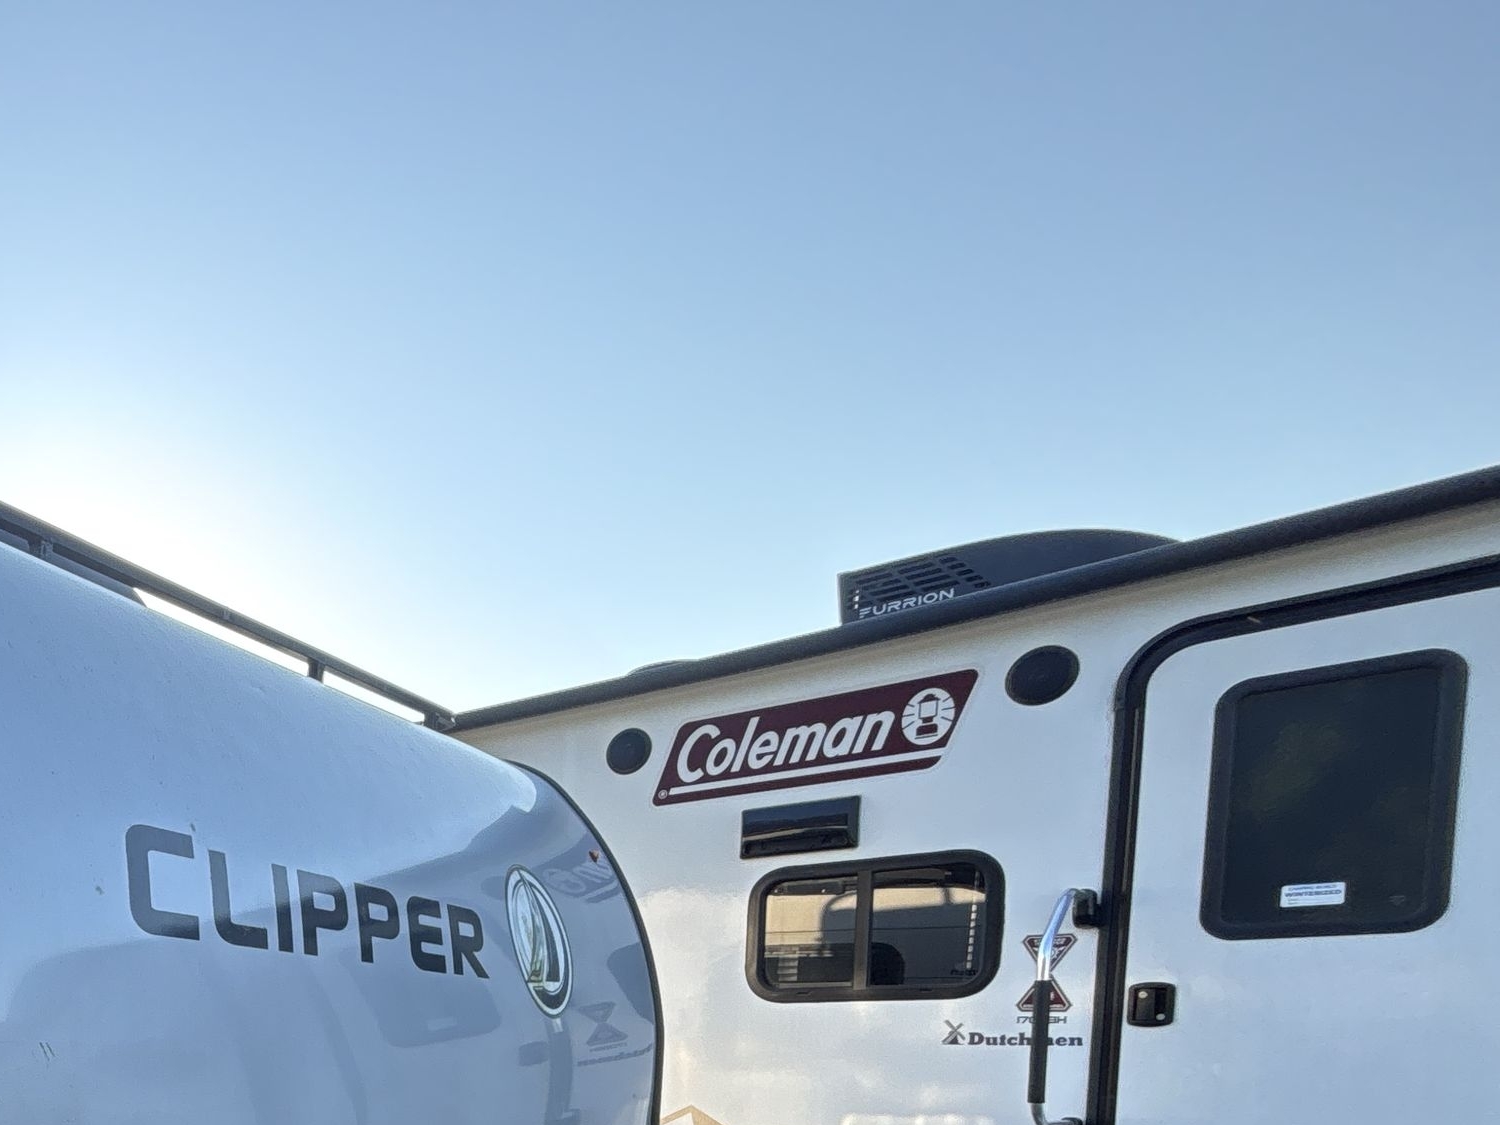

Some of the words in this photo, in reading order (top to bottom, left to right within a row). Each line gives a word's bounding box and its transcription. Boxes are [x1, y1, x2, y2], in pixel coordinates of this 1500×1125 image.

[858, 587, 955, 619] FURRION
[676, 710, 896, 784] Coleman
[125, 823, 490, 980] CLIPPER
